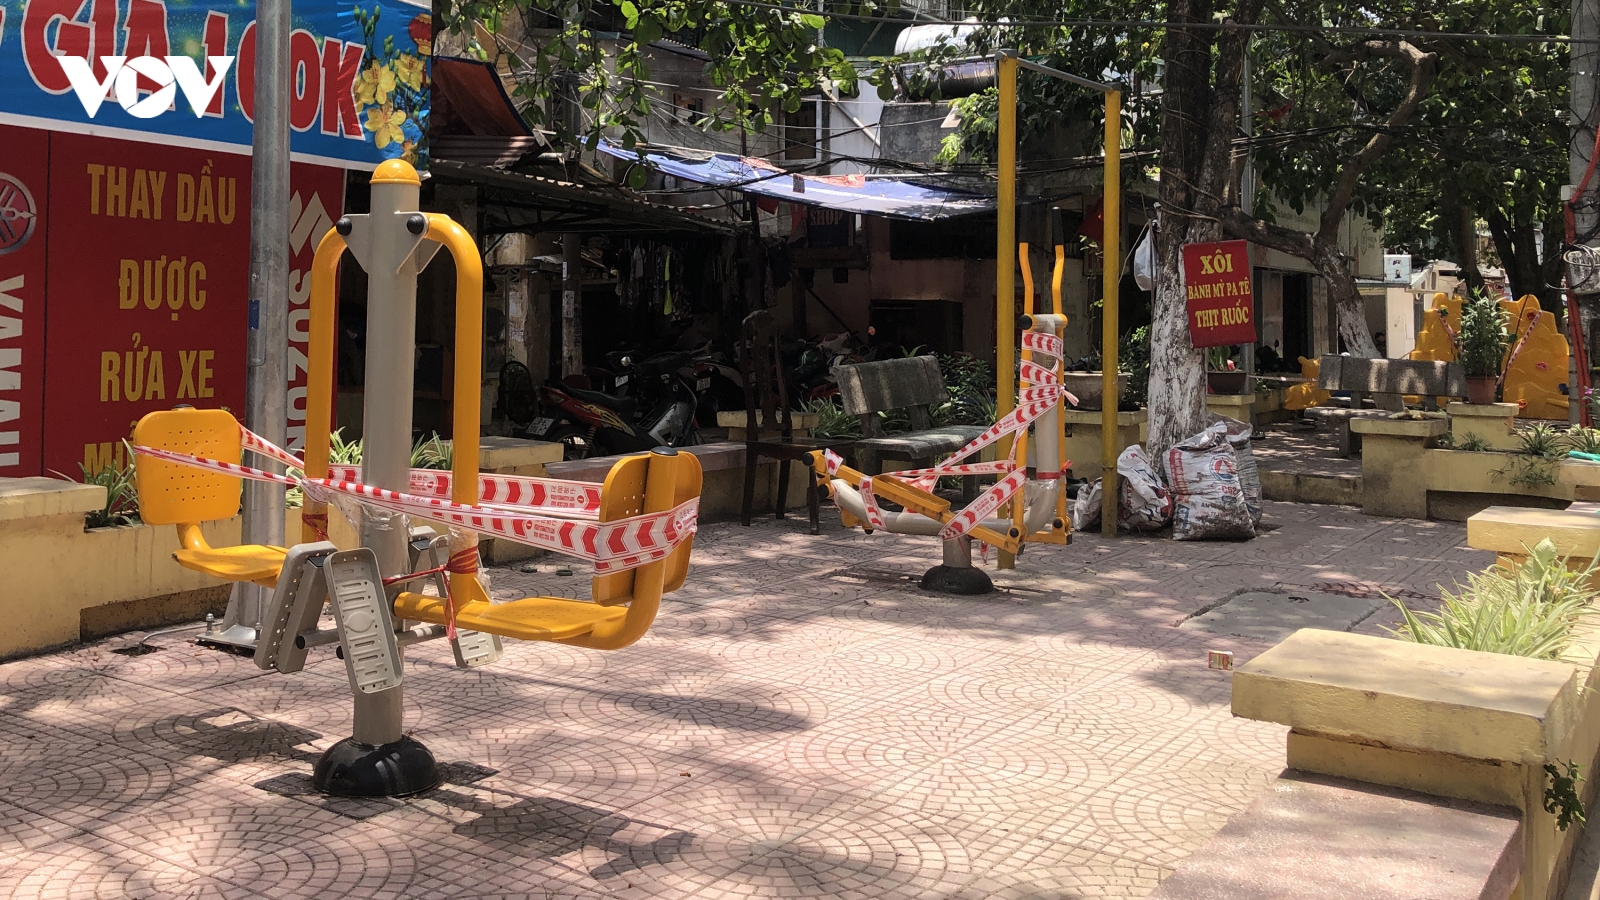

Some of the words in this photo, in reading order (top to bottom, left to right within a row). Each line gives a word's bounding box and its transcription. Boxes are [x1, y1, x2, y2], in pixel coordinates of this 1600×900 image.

[87, 162, 167, 220] THAY
[177, 158, 237, 225] DẦU
[810, 210, 843, 226] SHOP
[1200, 249, 1233, 275] XÔI
[118, 255, 207, 321] ĐƯỢC
[1188, 281, 1211, 300] BÁNH
[1213, 278, 1225, 297] MỲ
[1227, 282, 1238, 296] PA
[1238, 277, 1251, 295] TÊ
[1195, 309, 1220, 330] THỊT
[1222, 299, 1249, 325] RUỐC
[101, 332, 166, 402] RỬA
[177, 350, 215, 400] XE
